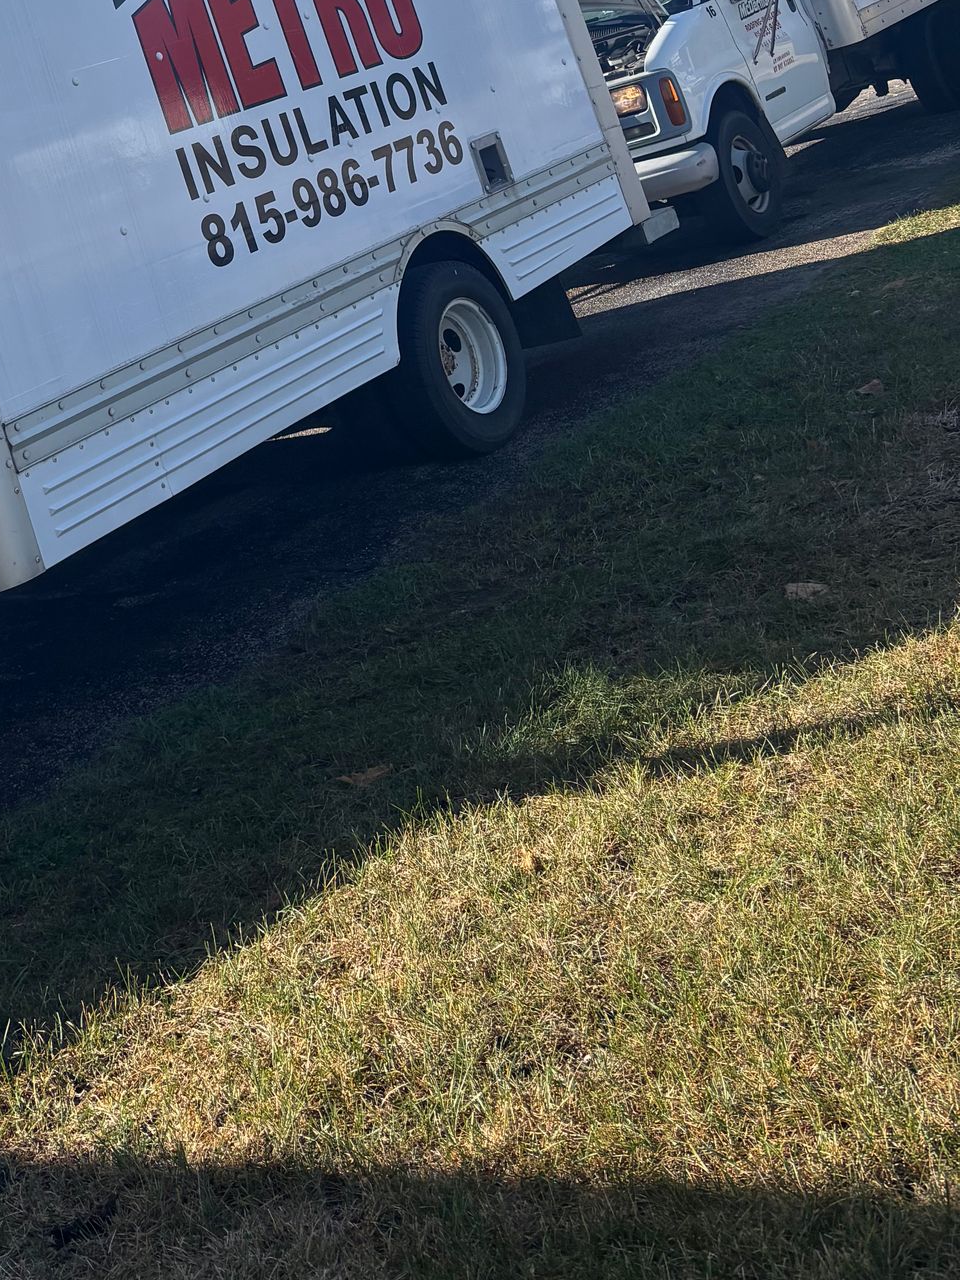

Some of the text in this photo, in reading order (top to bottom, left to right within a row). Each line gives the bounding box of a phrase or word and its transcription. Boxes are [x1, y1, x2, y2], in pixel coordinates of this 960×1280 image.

[706, 5, 717, 19] 16
[175, 61, 448, 201] INSULATION
[200, 120, 464, 267] 815-986-7736
